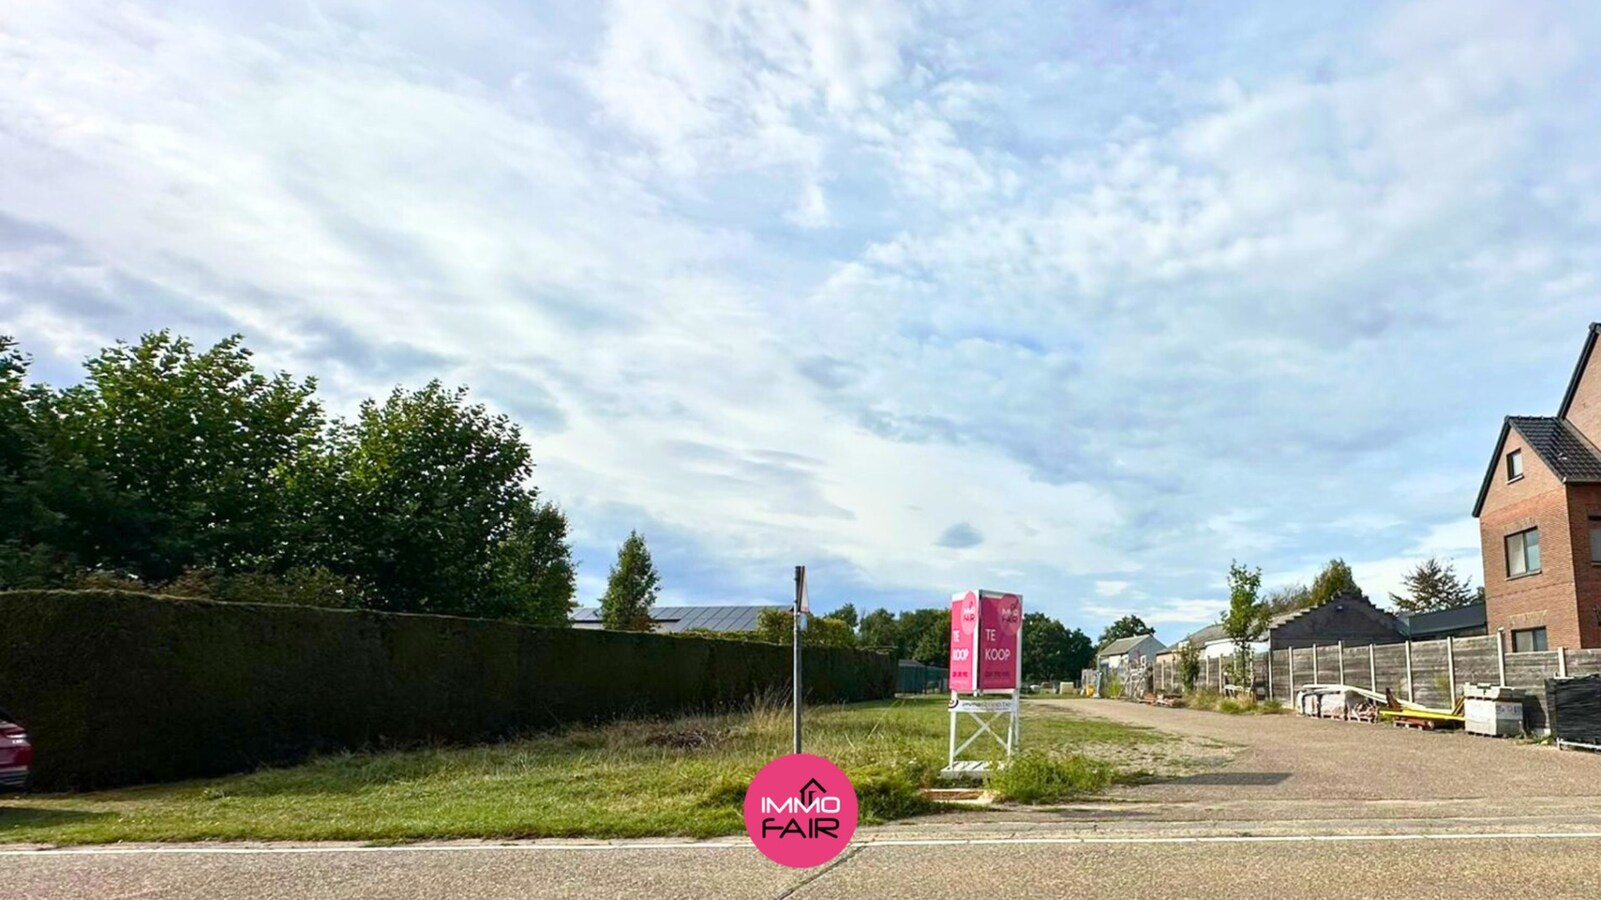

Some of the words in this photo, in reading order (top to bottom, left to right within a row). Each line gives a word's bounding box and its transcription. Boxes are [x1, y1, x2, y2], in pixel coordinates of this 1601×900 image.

[953, 630, 960, 642] TE
[985, 629, 996, 641] TE
[953, 648, 969, 661] KOOP
[985, 648, 1011, 661] KOOP
